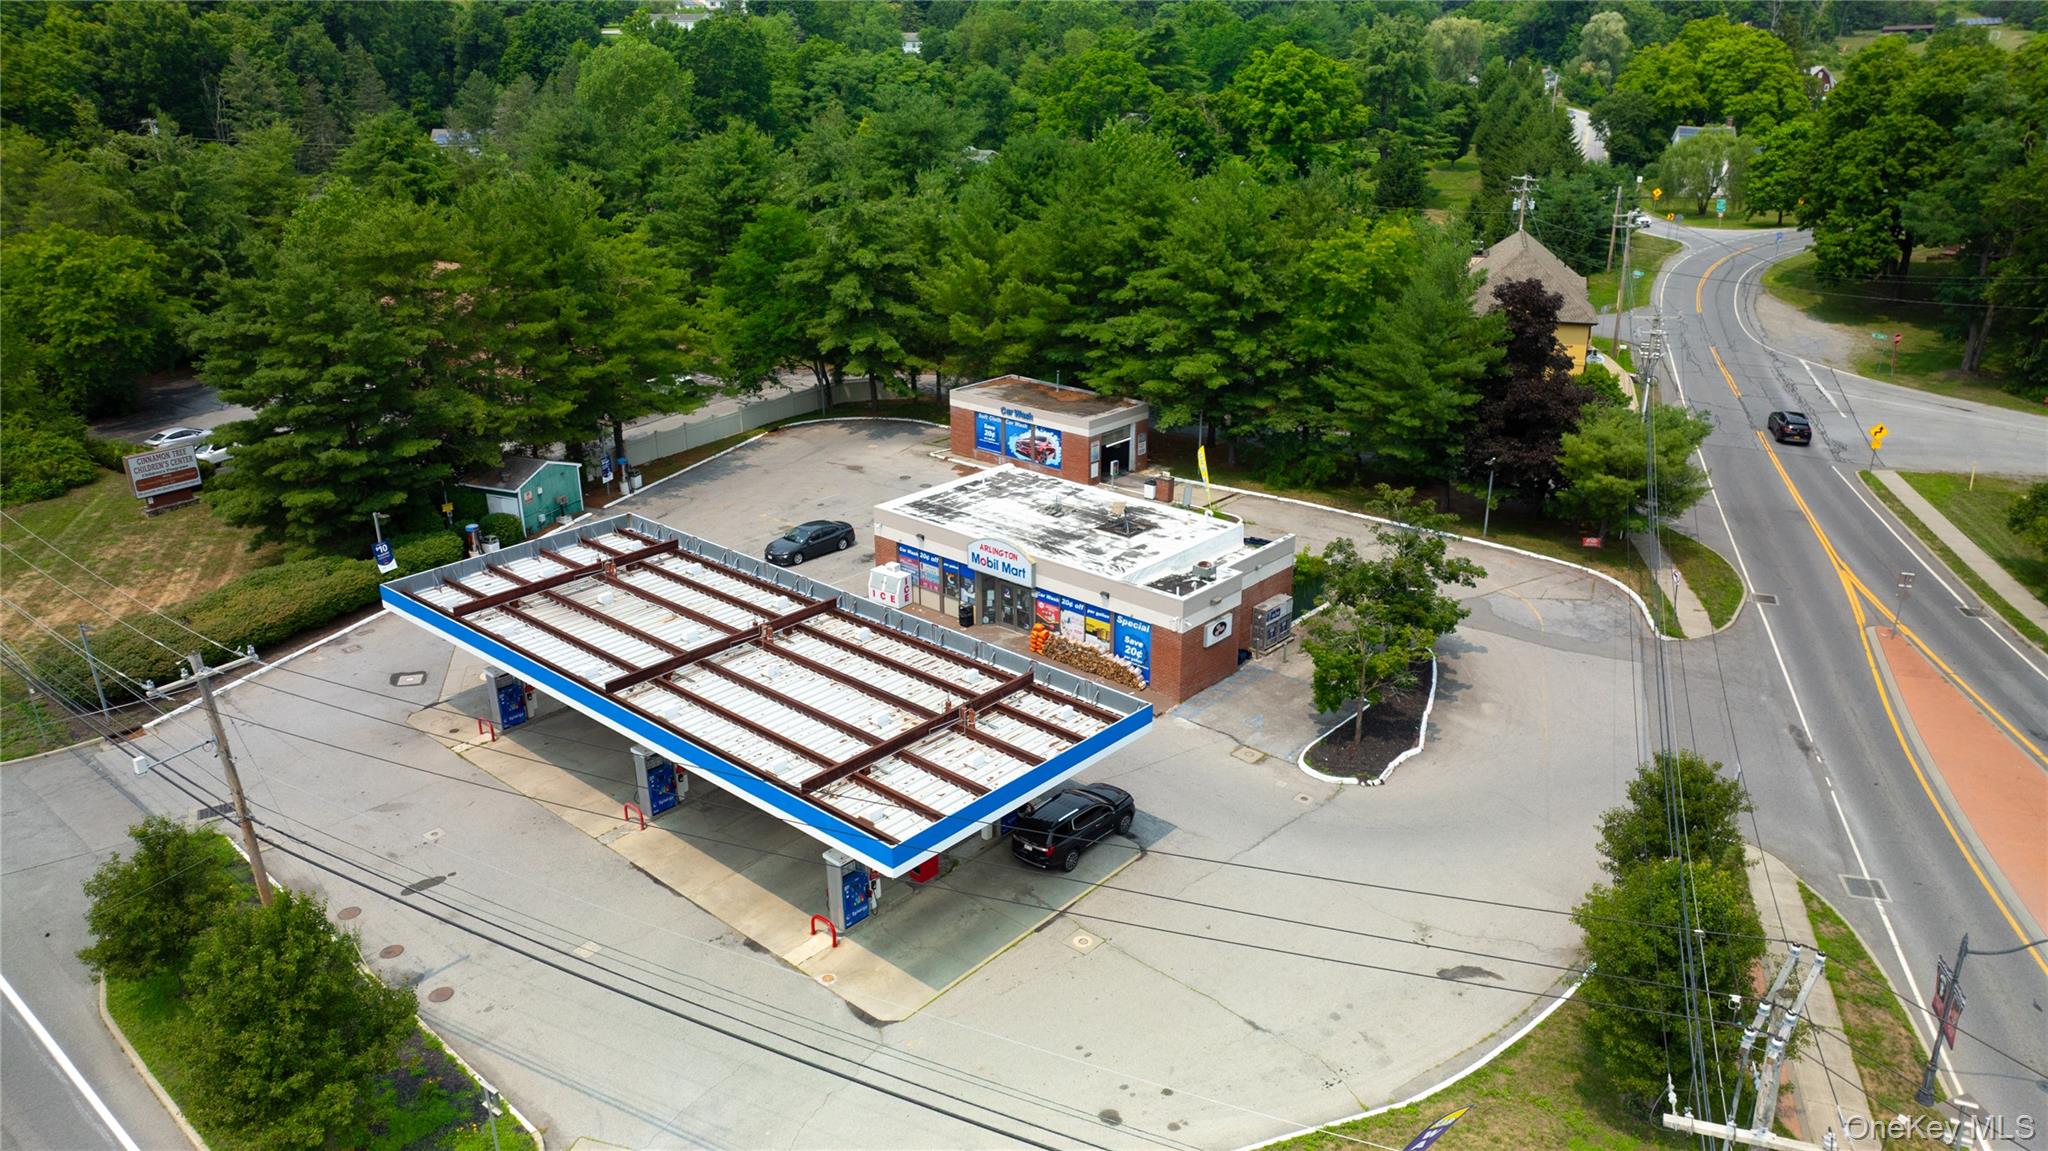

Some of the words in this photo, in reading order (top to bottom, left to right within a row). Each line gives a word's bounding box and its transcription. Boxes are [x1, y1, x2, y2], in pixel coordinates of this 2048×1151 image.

[1000, 406, 1014, 416] Car
[1014, 409, 1034, 421] Wash
[133, 460, 170, 474] CHILDREN'S
[170, 455, 193, 466] CENTER
[136, 451, 171, 465] CINNAMON
[172, 448, 187, 457] TREE
[979, 543, 1018, 561] ARLINGTON
[971, 551, 999, 571] Mobil
[1001, 561, 1026, 579] Mart
[872, 589, 896, 603] ICE
[1061, 598, 1073, 608] 20¢
[1116, 615, 1151, 633] Special
[1124, 635, 1144, 648] Save
[1124, 644, 1143, 659] 20¢
